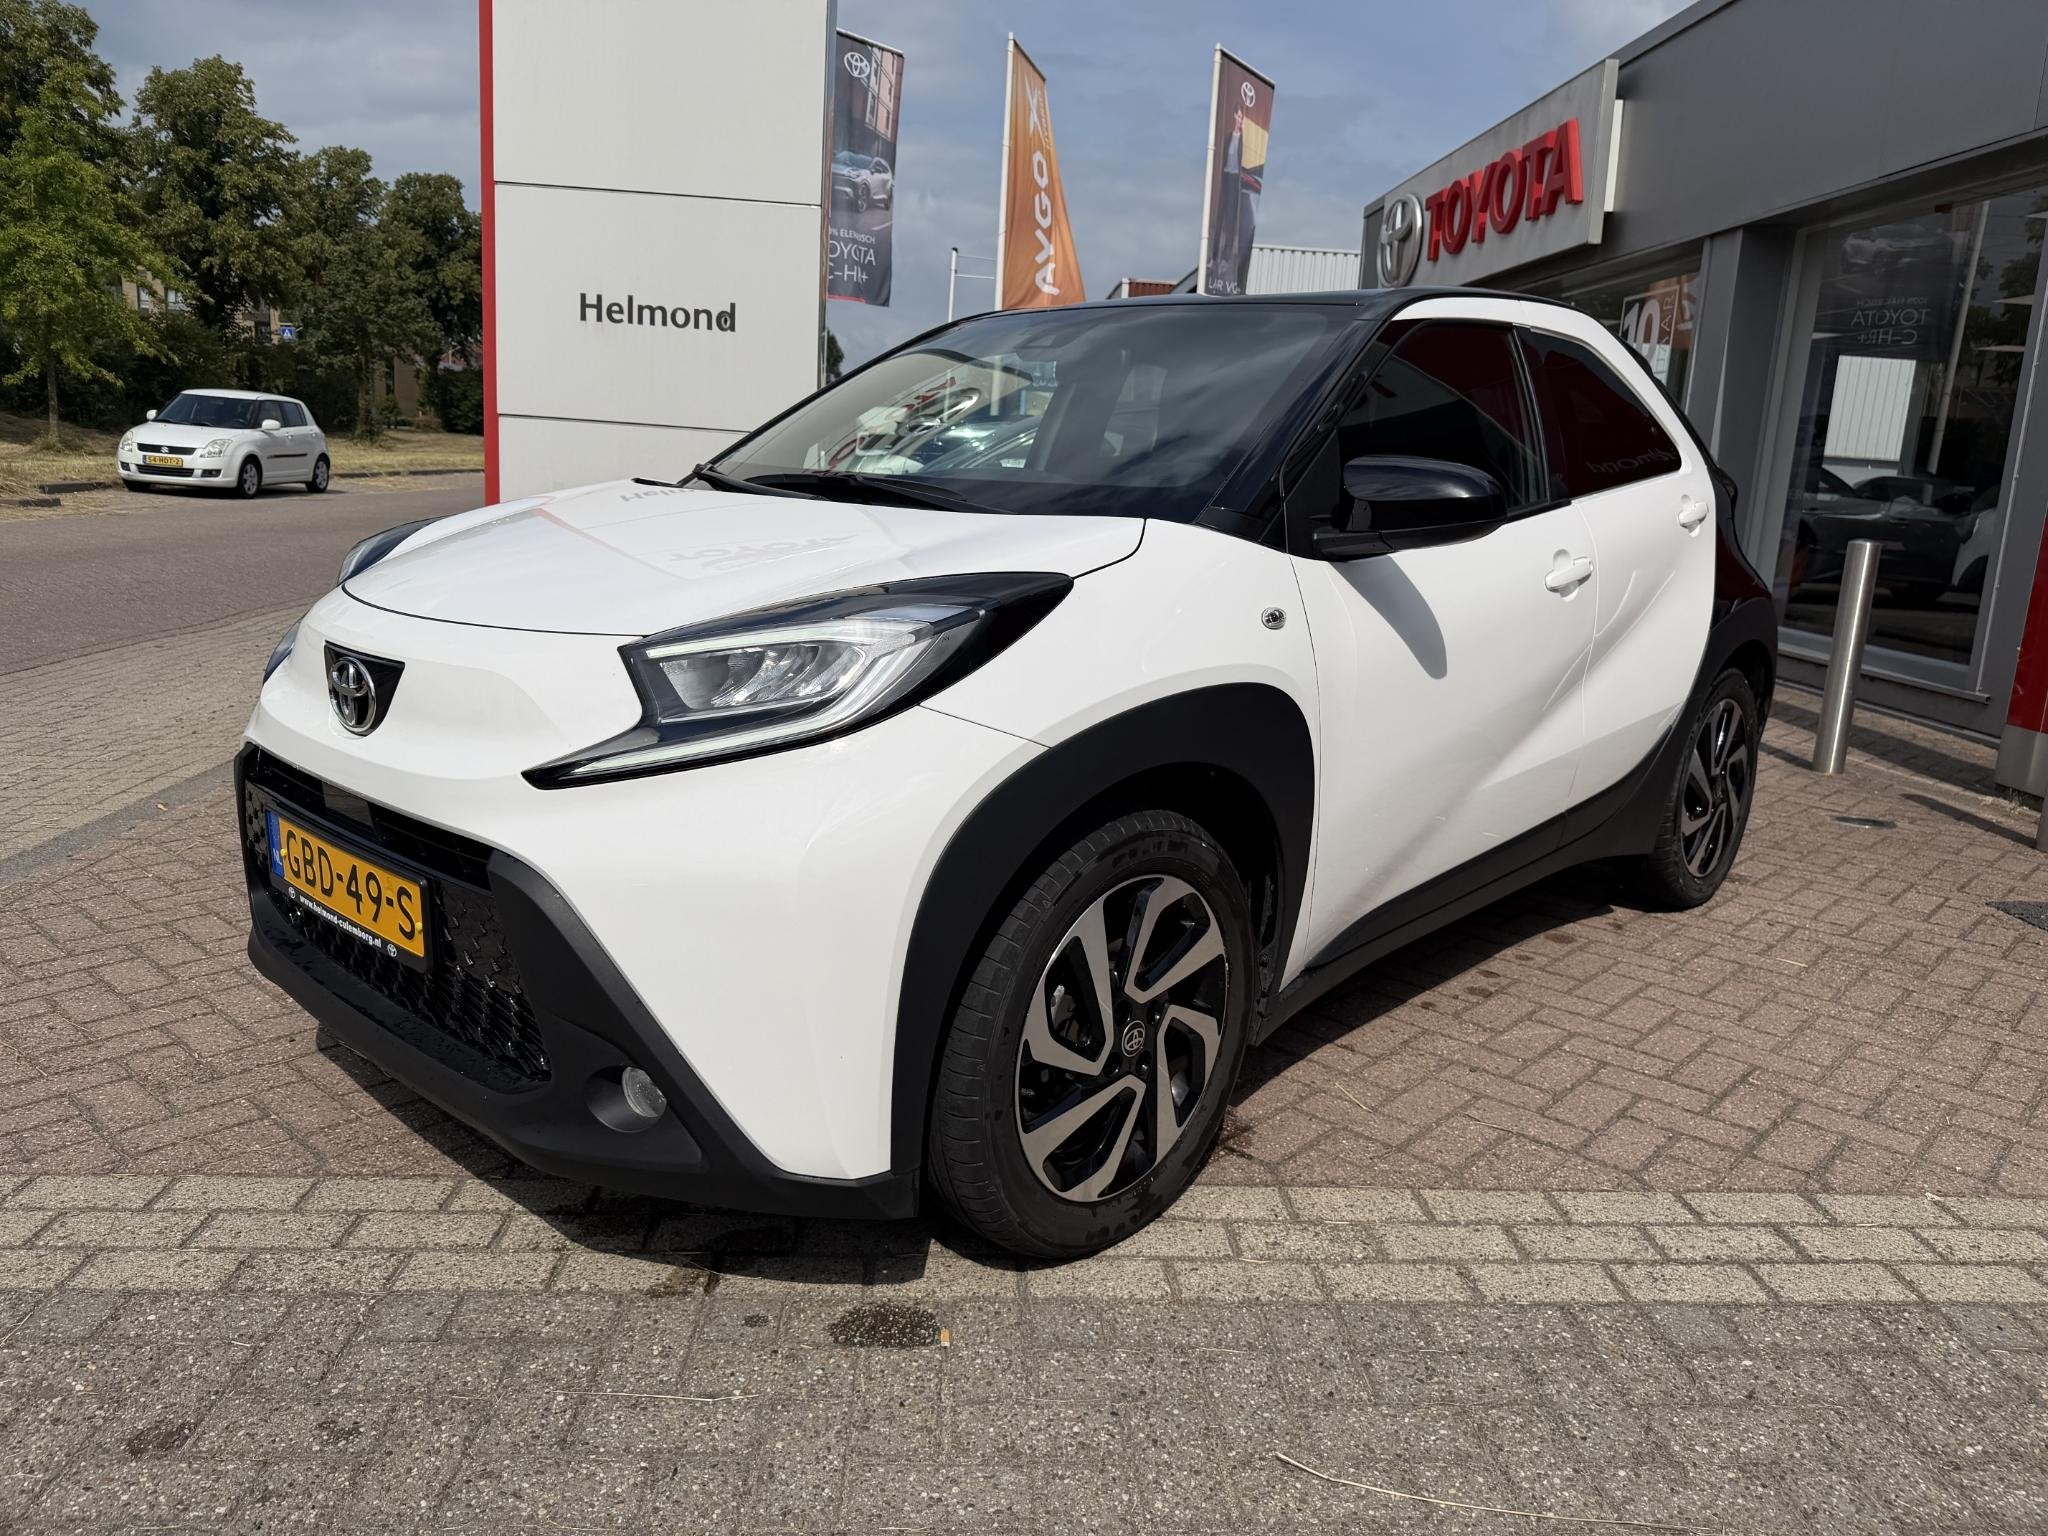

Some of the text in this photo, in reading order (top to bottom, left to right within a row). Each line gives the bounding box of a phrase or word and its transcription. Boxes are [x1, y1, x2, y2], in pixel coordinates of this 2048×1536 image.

[1425, 118, 1584, 262] TOYOTA
[829, 241, 876, 266] OYOTA
[1034, 151, 1060, 295] AYGO
[579, 292, 737, 333] Helmond
[1622, 298, 1661, 362] 10
[272, 847, 283, 866] NL
[286, 829, 416, 941] GBD-49-S
